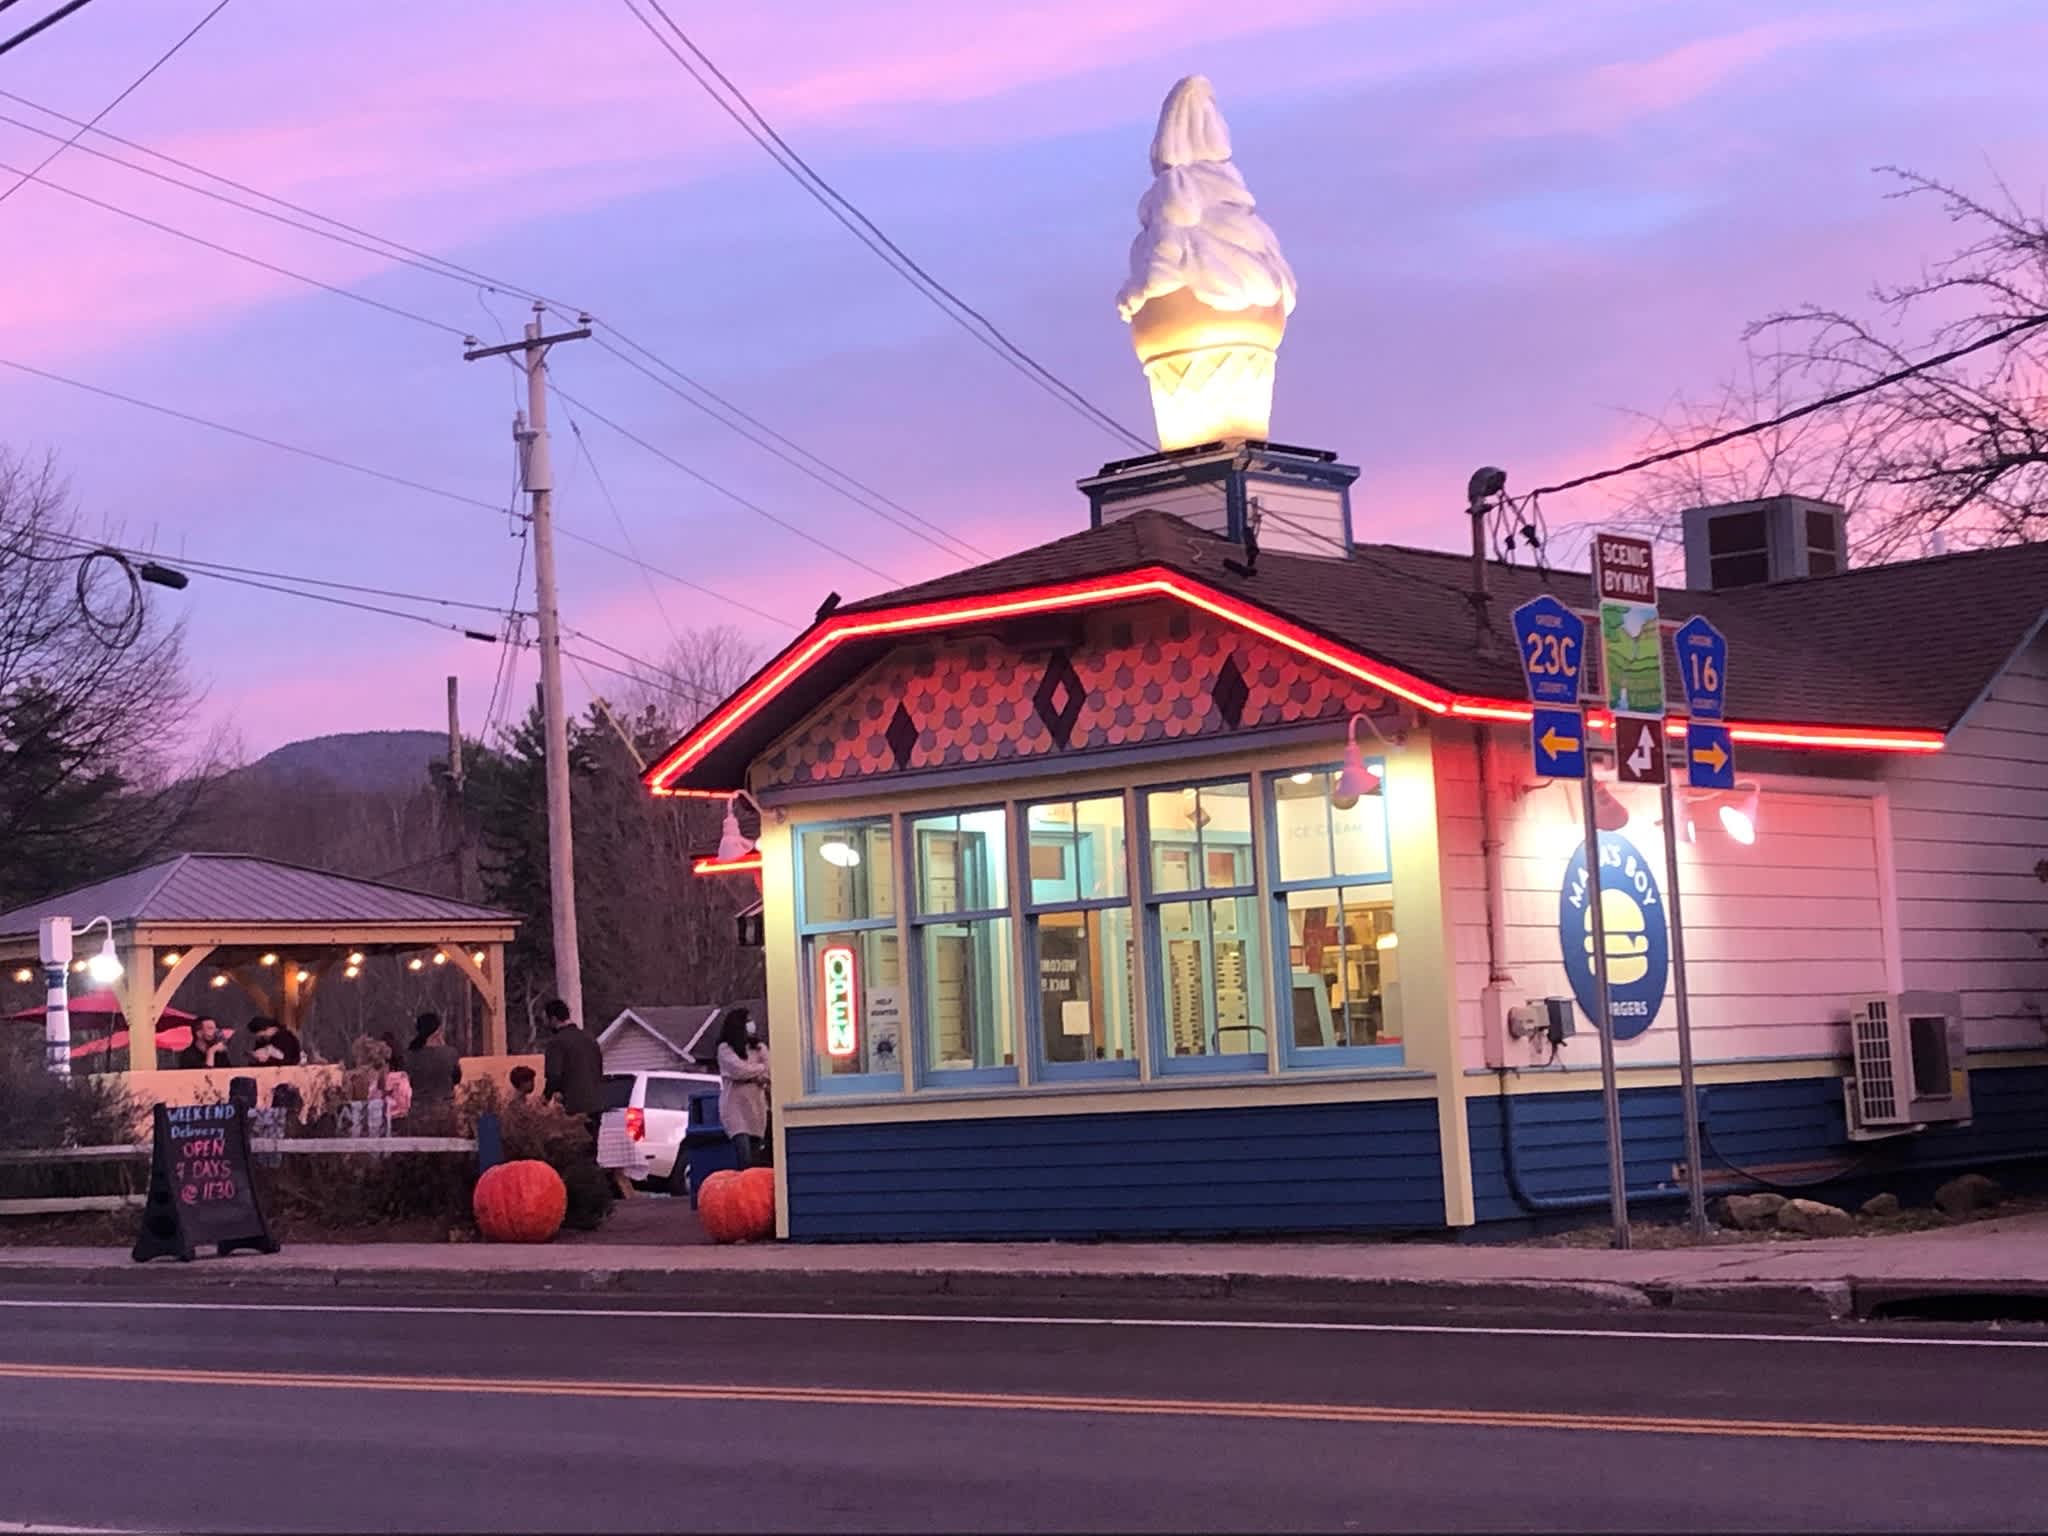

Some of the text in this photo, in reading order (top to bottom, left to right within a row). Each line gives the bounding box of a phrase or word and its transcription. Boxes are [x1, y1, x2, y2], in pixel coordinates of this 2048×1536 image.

[1603, 542, 1649, 569] SCENIC
[1605, 569, 1649, 595] BYWAY
[1527, 632, 1577, 677] 23C
[1691, 653, 1718, 692] 16
[1624, 855, 1657, 906] BOY
[828, 954, 850, 1049] OPEN
[1609, 1001, 1649, 1017] RGERS
[167, 1104, 236, 1123] WEEKEND
[171, 1124, 225, 1140] Delivery
[183, 1138, 226, 1158] OPEN
[192, 1159, 233, 1179] DAYS
[181, 1183, 199, 1205] @
